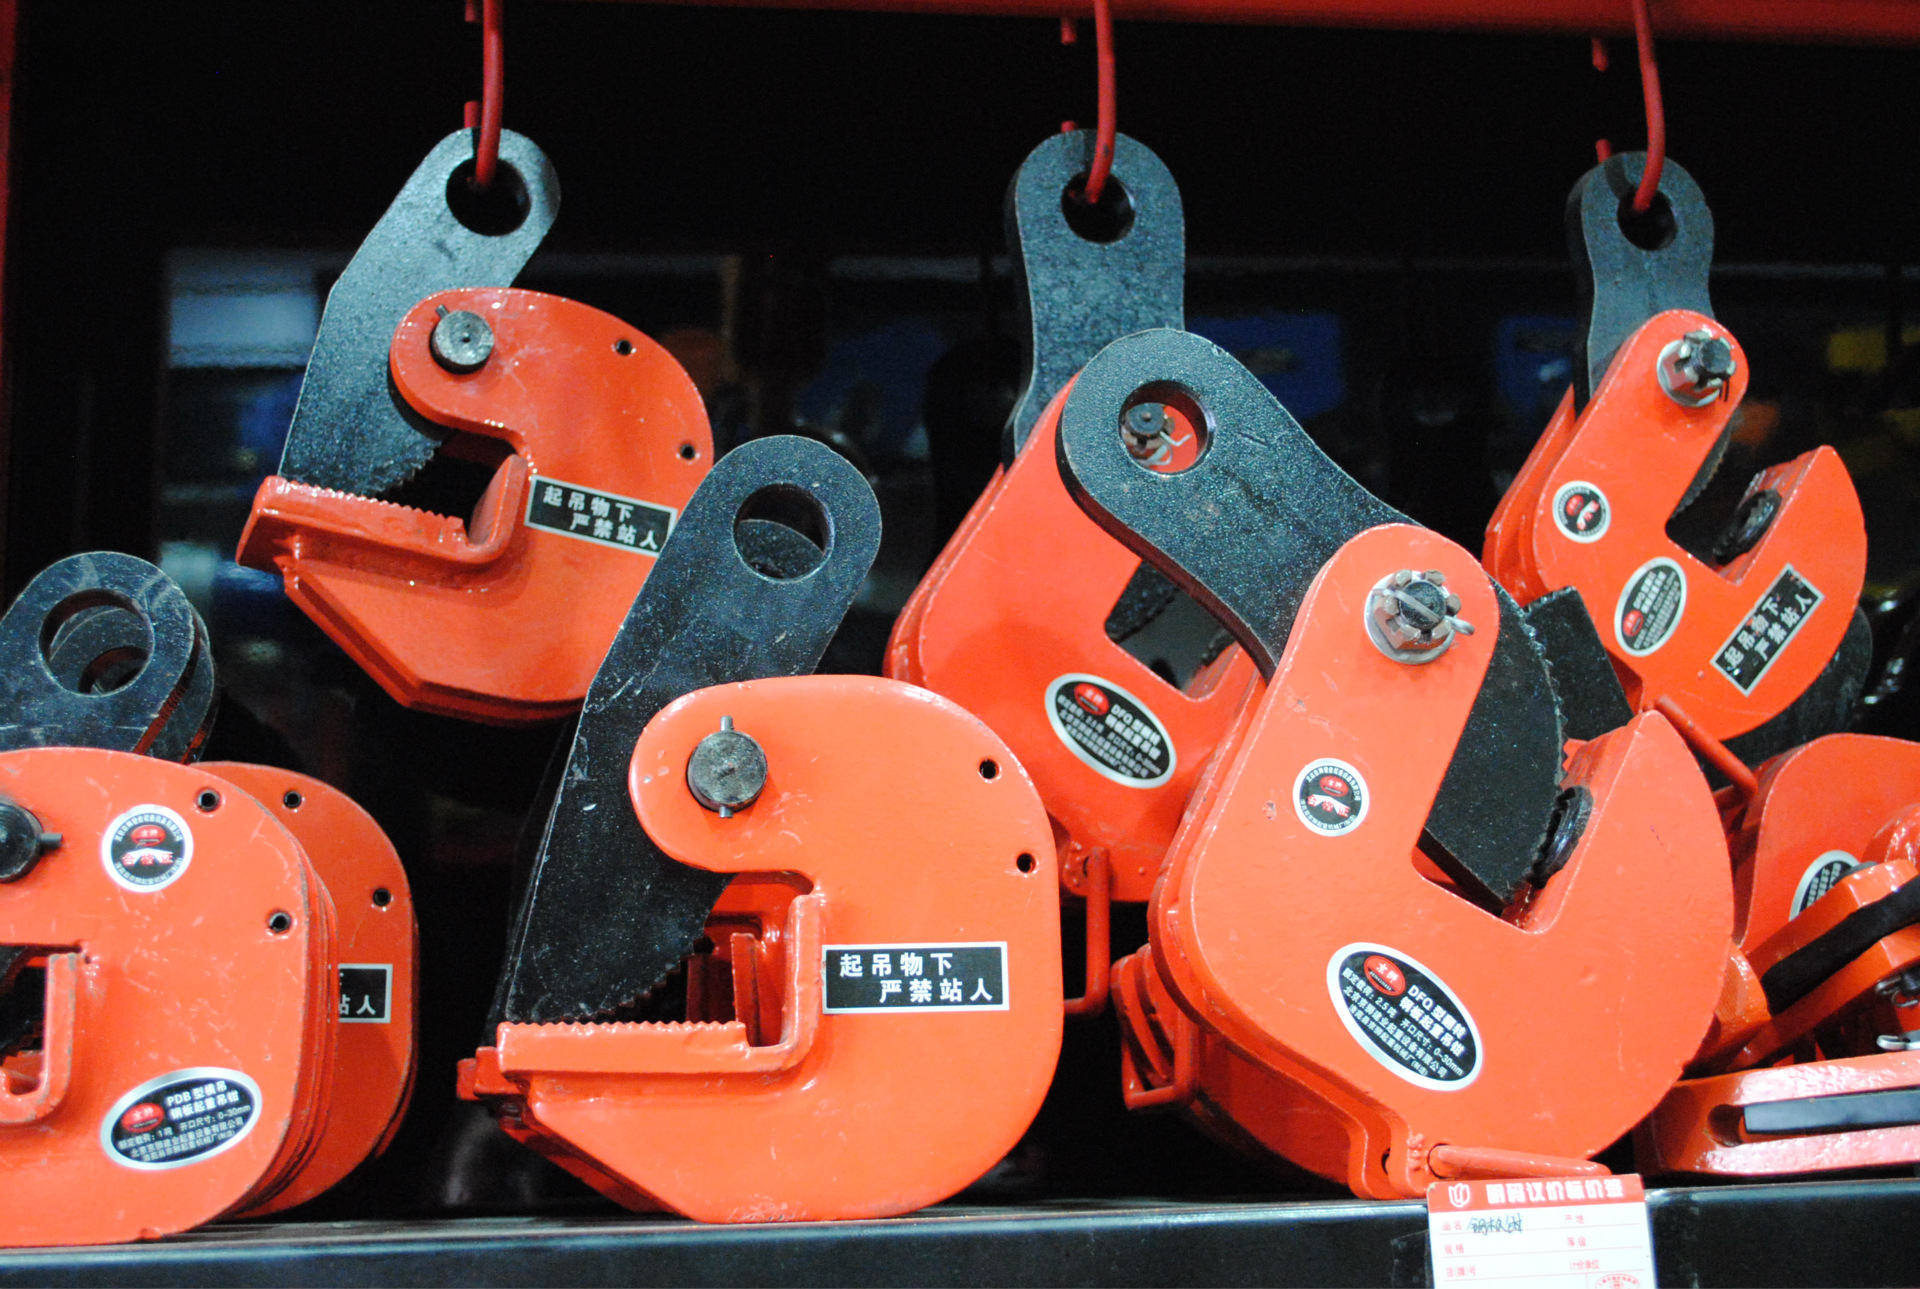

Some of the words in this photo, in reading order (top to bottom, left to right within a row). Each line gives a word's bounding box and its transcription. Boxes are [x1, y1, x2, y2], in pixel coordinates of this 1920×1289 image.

[543, 485, 634, 523] 起吊物下
[569, 512, 659, 551] 严禁站人
[1723, 596, 1779, 669] 起吊物下
[1754, 593, 1813, 662] 严禁站人
[839, 952, 954, 978] 起吊物下
[879, 977, 994, 1004] 严禁站人
[1407, 984, 1435, 1009] DFQ
[1399, 996, 1466, 1058] 钢板起重吊钳
[166, 1090, 192, 1107] PDB
[169, 1089, 241, 1121] 钢板起重吊钳
